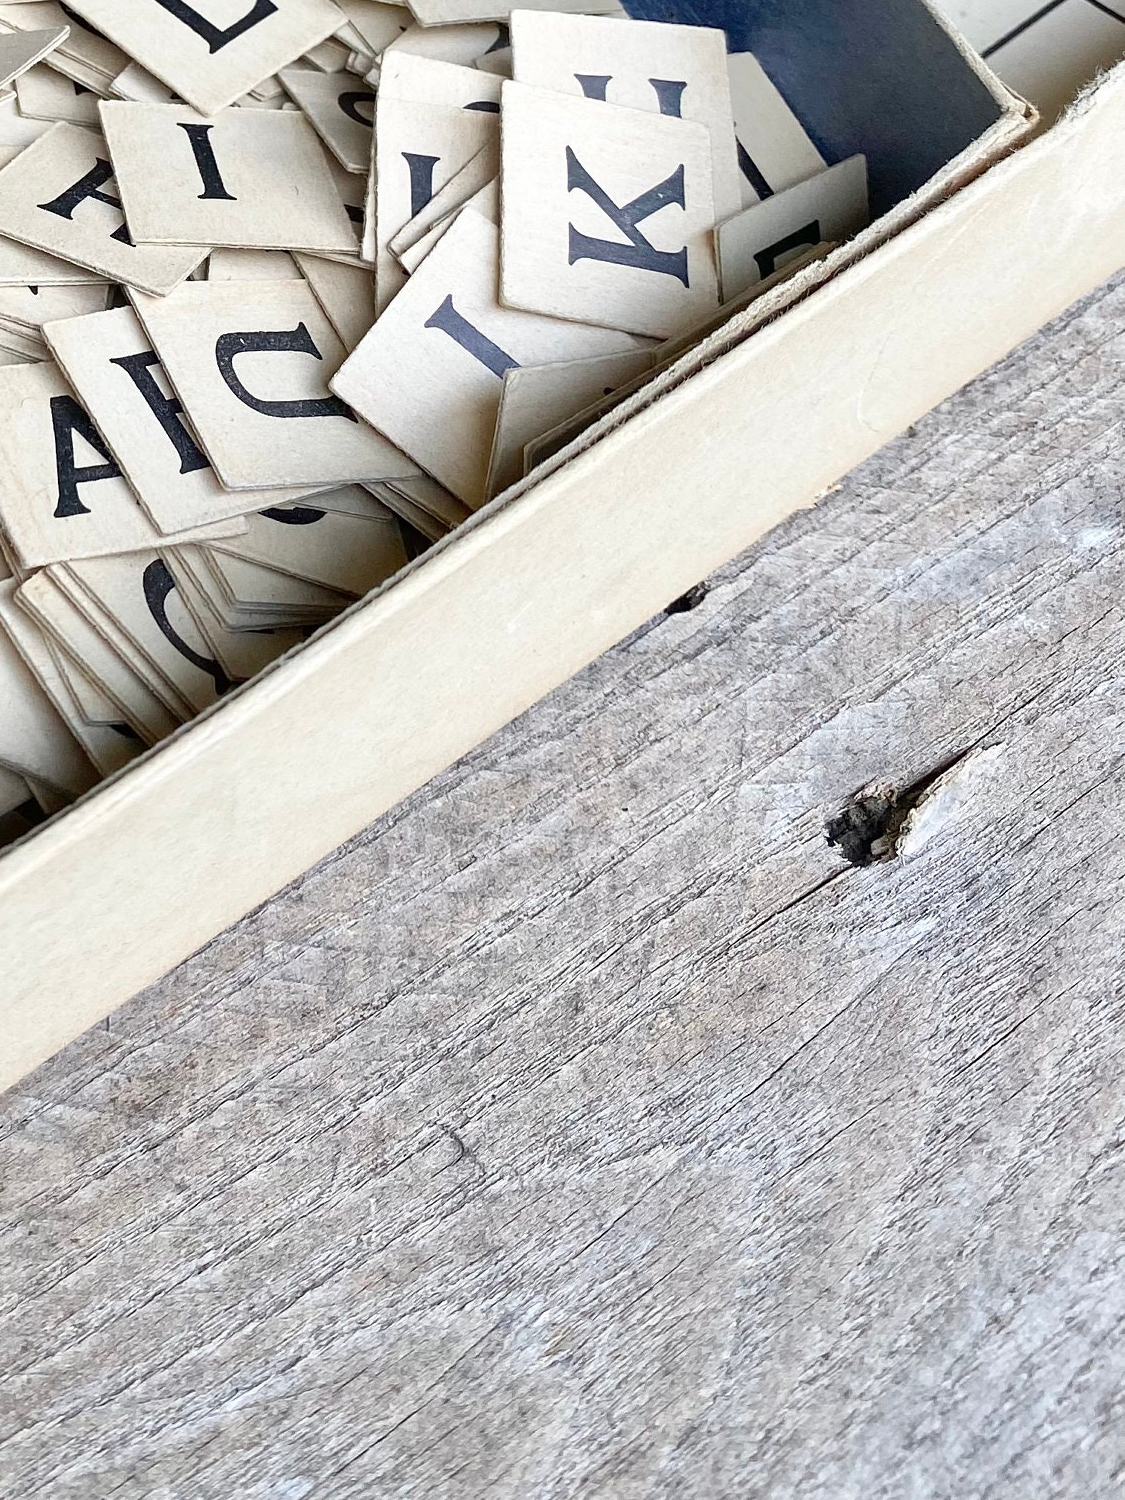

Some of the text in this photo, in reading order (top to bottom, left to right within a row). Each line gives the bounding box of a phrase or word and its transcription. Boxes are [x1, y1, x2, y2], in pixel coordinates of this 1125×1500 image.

[176, 122, 238, 201] I
[565, 145, 690, 289] K
[214, 321, 359, 424] U
